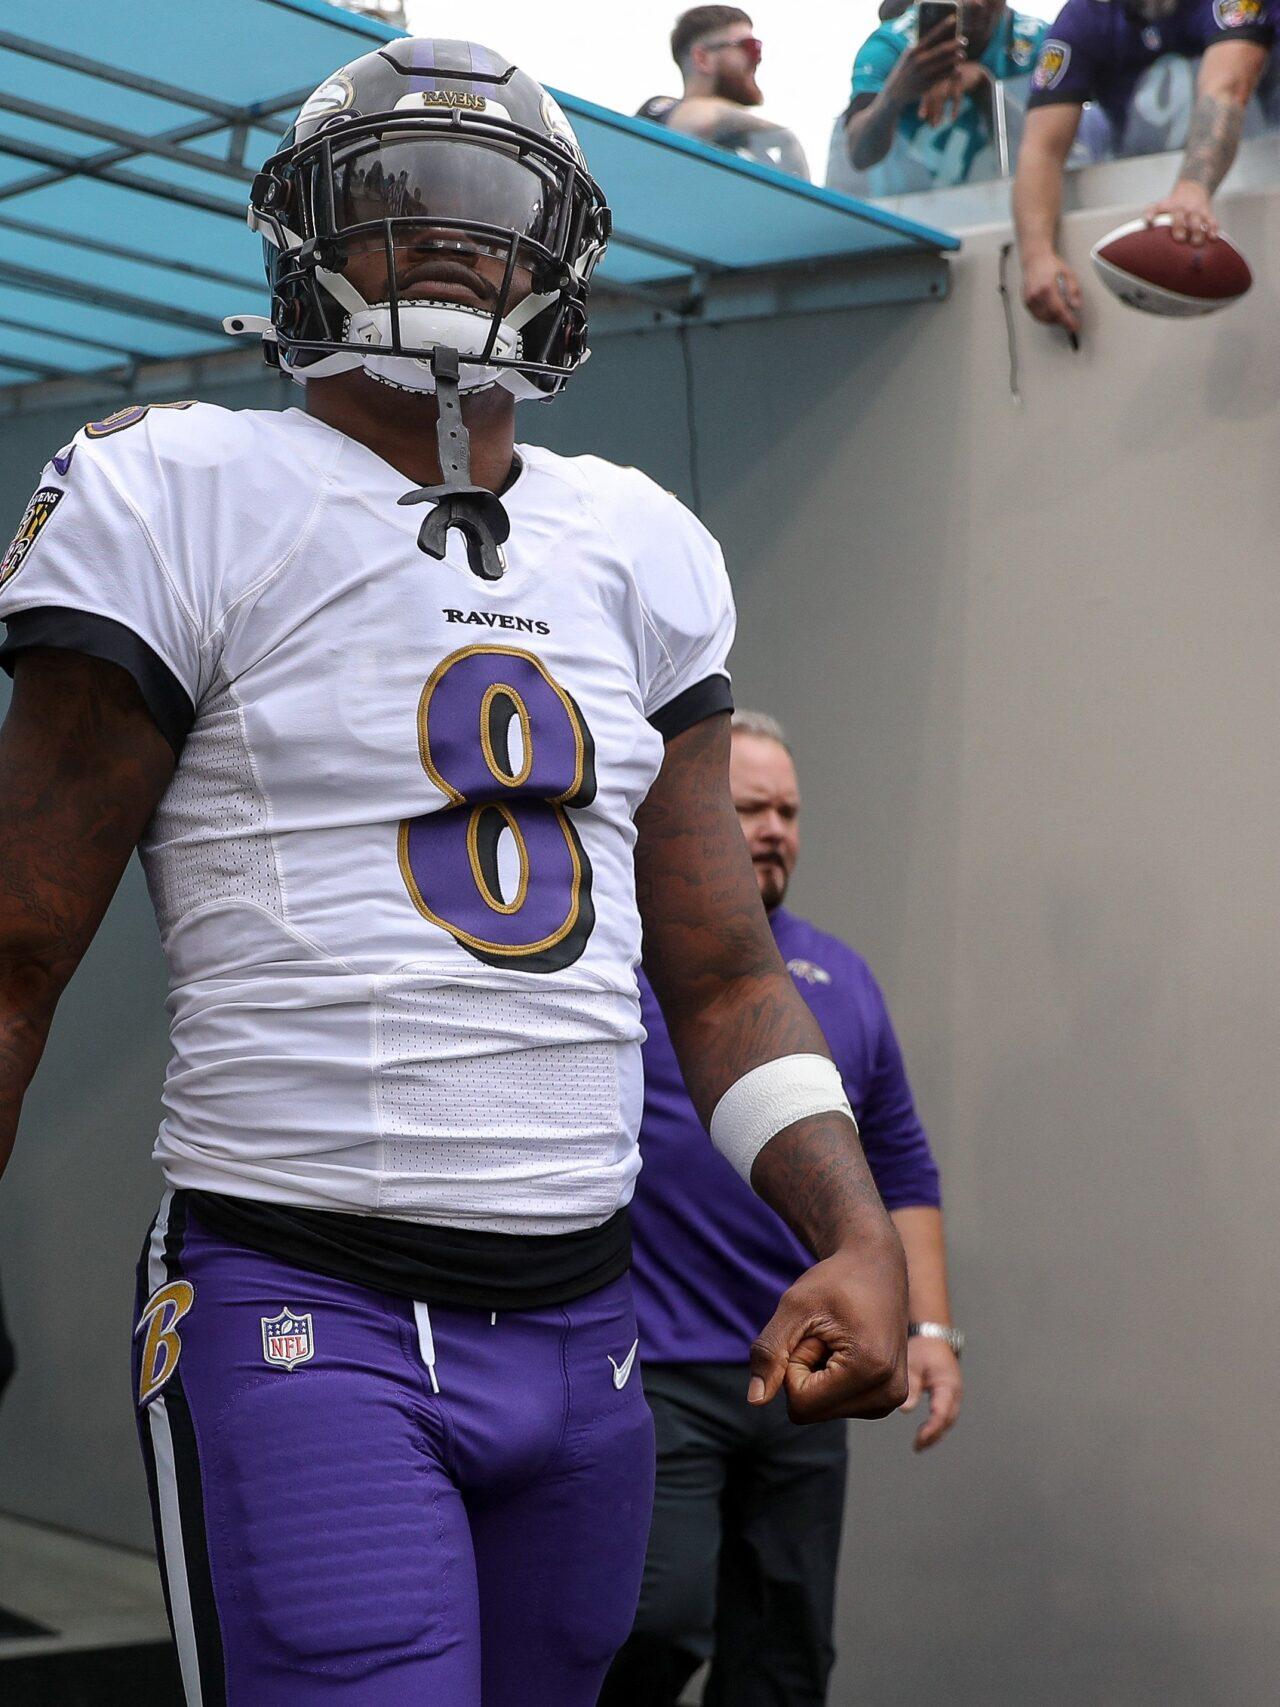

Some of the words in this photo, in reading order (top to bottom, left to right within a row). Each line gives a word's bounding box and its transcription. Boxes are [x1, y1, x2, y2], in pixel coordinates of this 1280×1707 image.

[422, 90, 487, 112] RAVENS
[442, 608, 551, 635] RAVENS
[399, 643, 597, 973] 8
[271, 1336, 307, 1358] NFL
